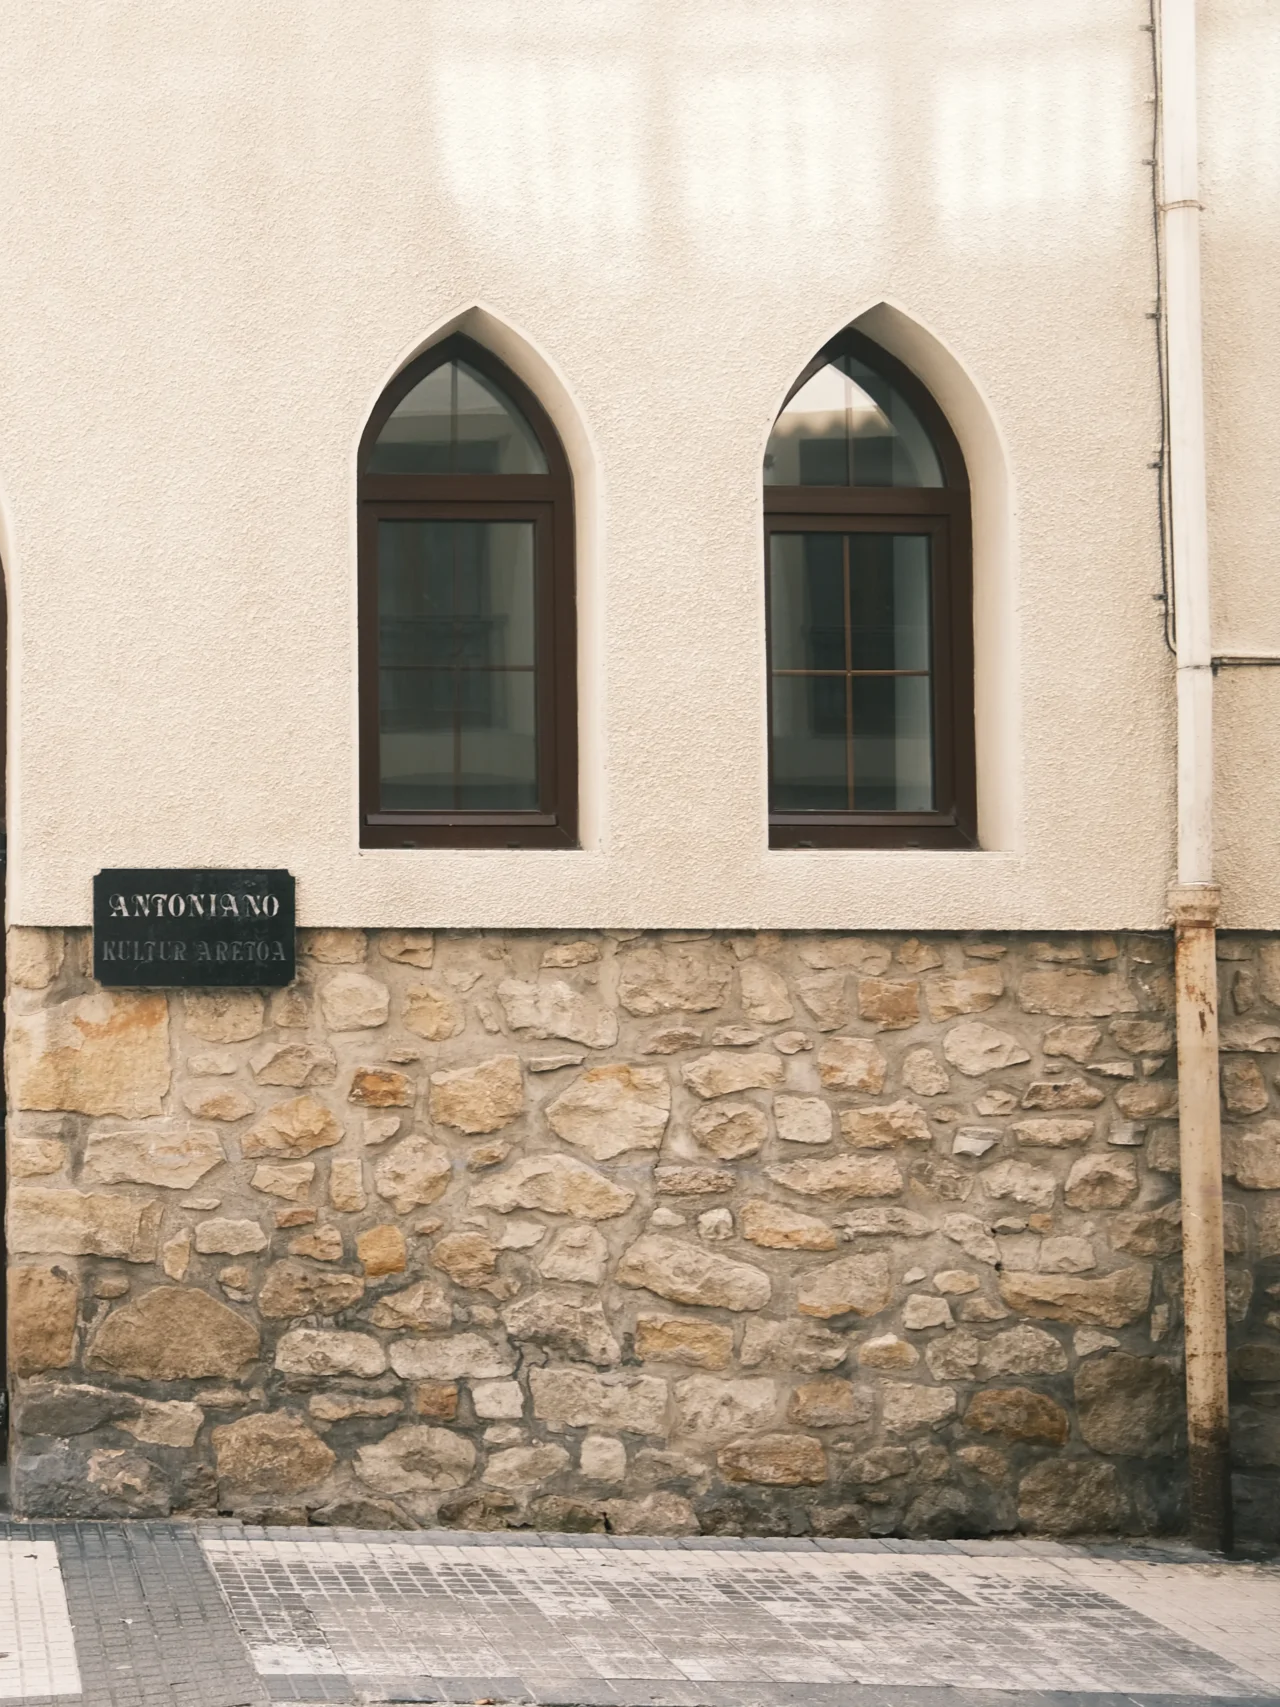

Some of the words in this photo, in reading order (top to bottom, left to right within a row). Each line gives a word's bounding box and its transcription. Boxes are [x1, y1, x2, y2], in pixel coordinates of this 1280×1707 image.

[109, 893, 280, 917] ANTONIANO
[103, 940, 187, 961] KULTUR
[194, 940, 287, 961] ARETOA
